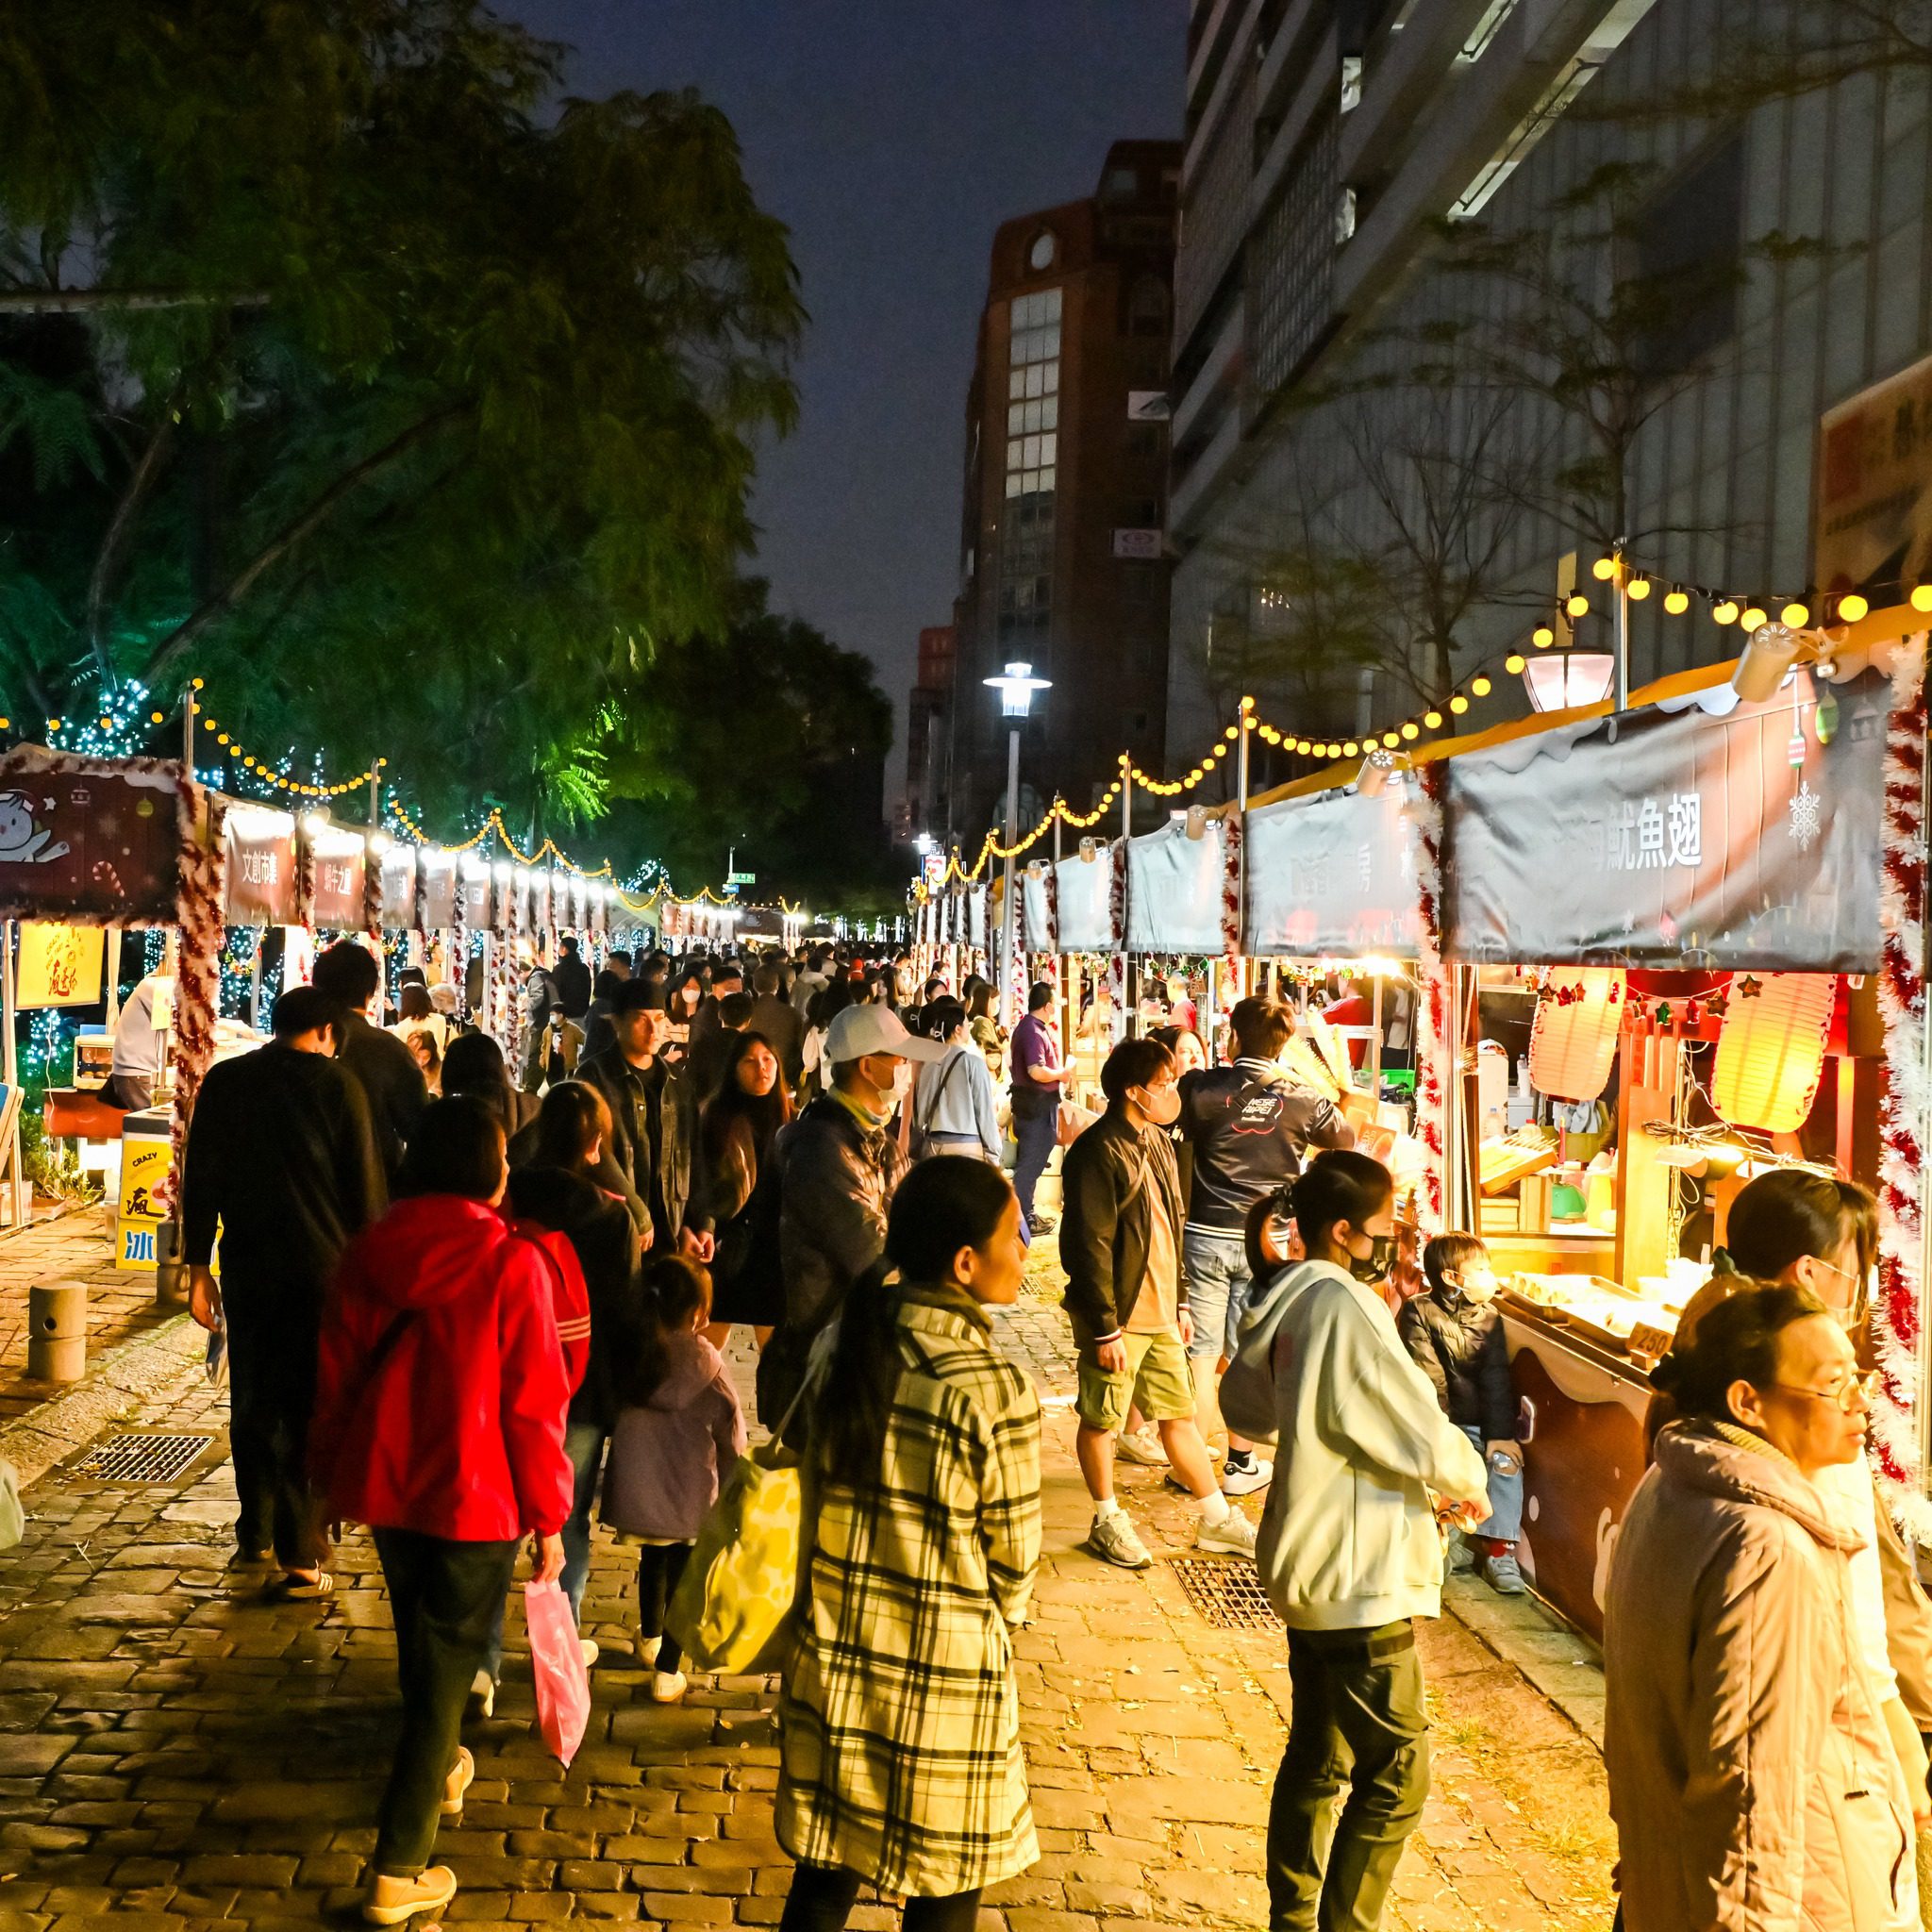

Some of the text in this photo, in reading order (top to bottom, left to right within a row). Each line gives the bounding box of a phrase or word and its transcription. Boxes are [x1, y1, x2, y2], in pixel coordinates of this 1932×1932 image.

[242, 848, 277, 886] 文創市集
[1241, 1105, 1273, 1115] AIPEI
[132, 1152, 158, 1167] CRAZY
[124, 1230, 157, 1261] 冰
[1636, 1328, 1668, 1356] 250
